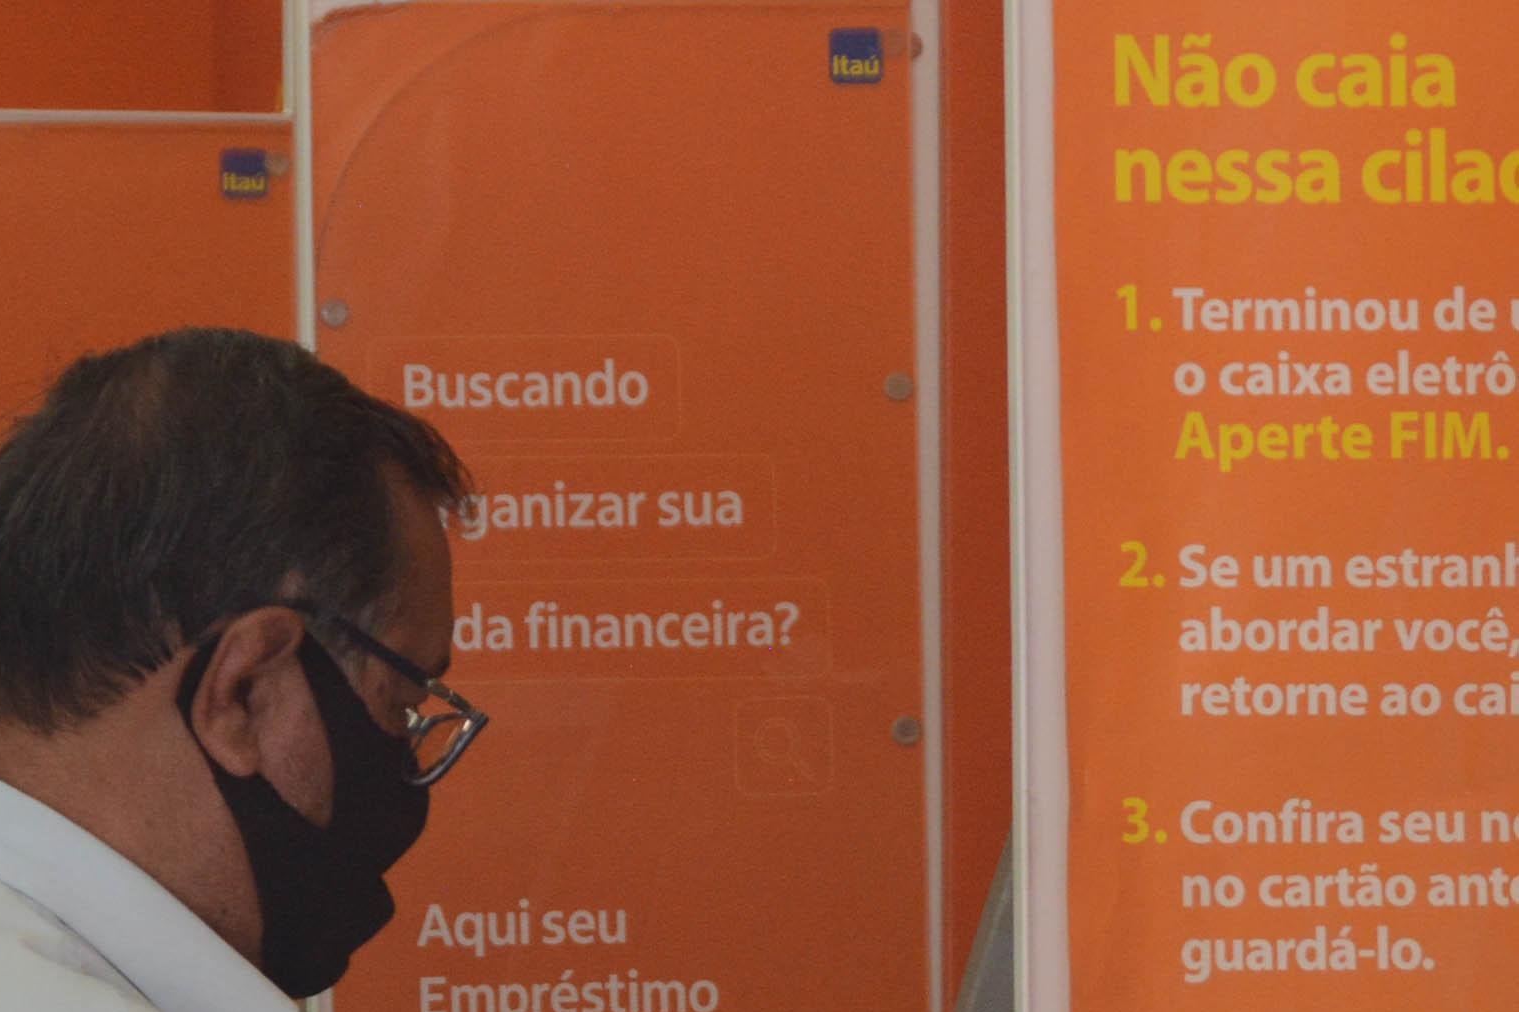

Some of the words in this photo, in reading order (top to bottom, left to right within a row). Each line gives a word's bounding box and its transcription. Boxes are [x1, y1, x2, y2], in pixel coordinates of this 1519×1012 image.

[1114, 33, 1278, 108] Não
[1296, 33, 1457, 108] caia
[1114, 147, 1341, 204] nessa
[1116, 283, 1163, 332] 1.
[1172, 285, 1420, 332] Terminou
[1433, 285, 1497, 332] de
[403, 359, 649, 408] Buscando
[1173, 361, 1206, 396] o
[1219, 351, 1351, 396] caixa
[1174, 410, 1374, 473] Aperte
[1390, 410, 1510, 460] FIM.
[657, 489, 743, 526] sua
[1119, 541, 1167, 588] 2.
[1179, 544, 1240, 588] Se
[1252, 553, 1332, 588] um
[524, 601, 799, 650] financeira?
[1179, 606, 1383, 652] abordar
[1181, 677, 1369, 716] retorne
[1380, 683, 1442, 716] ao
[1121, 797, 1168, 845] 3.
[1181, 798, 1365, 845] Confira
[1379, 809, 1466, 845] seu
[1181, 874, 1246, 907] no
[1259, 864, 1417, 907] cartão
[417, 898, 531, 957] Aqui
[542, 907, 627, 945] seu
[1181, 924, 1436, 984] guardá-lo.
